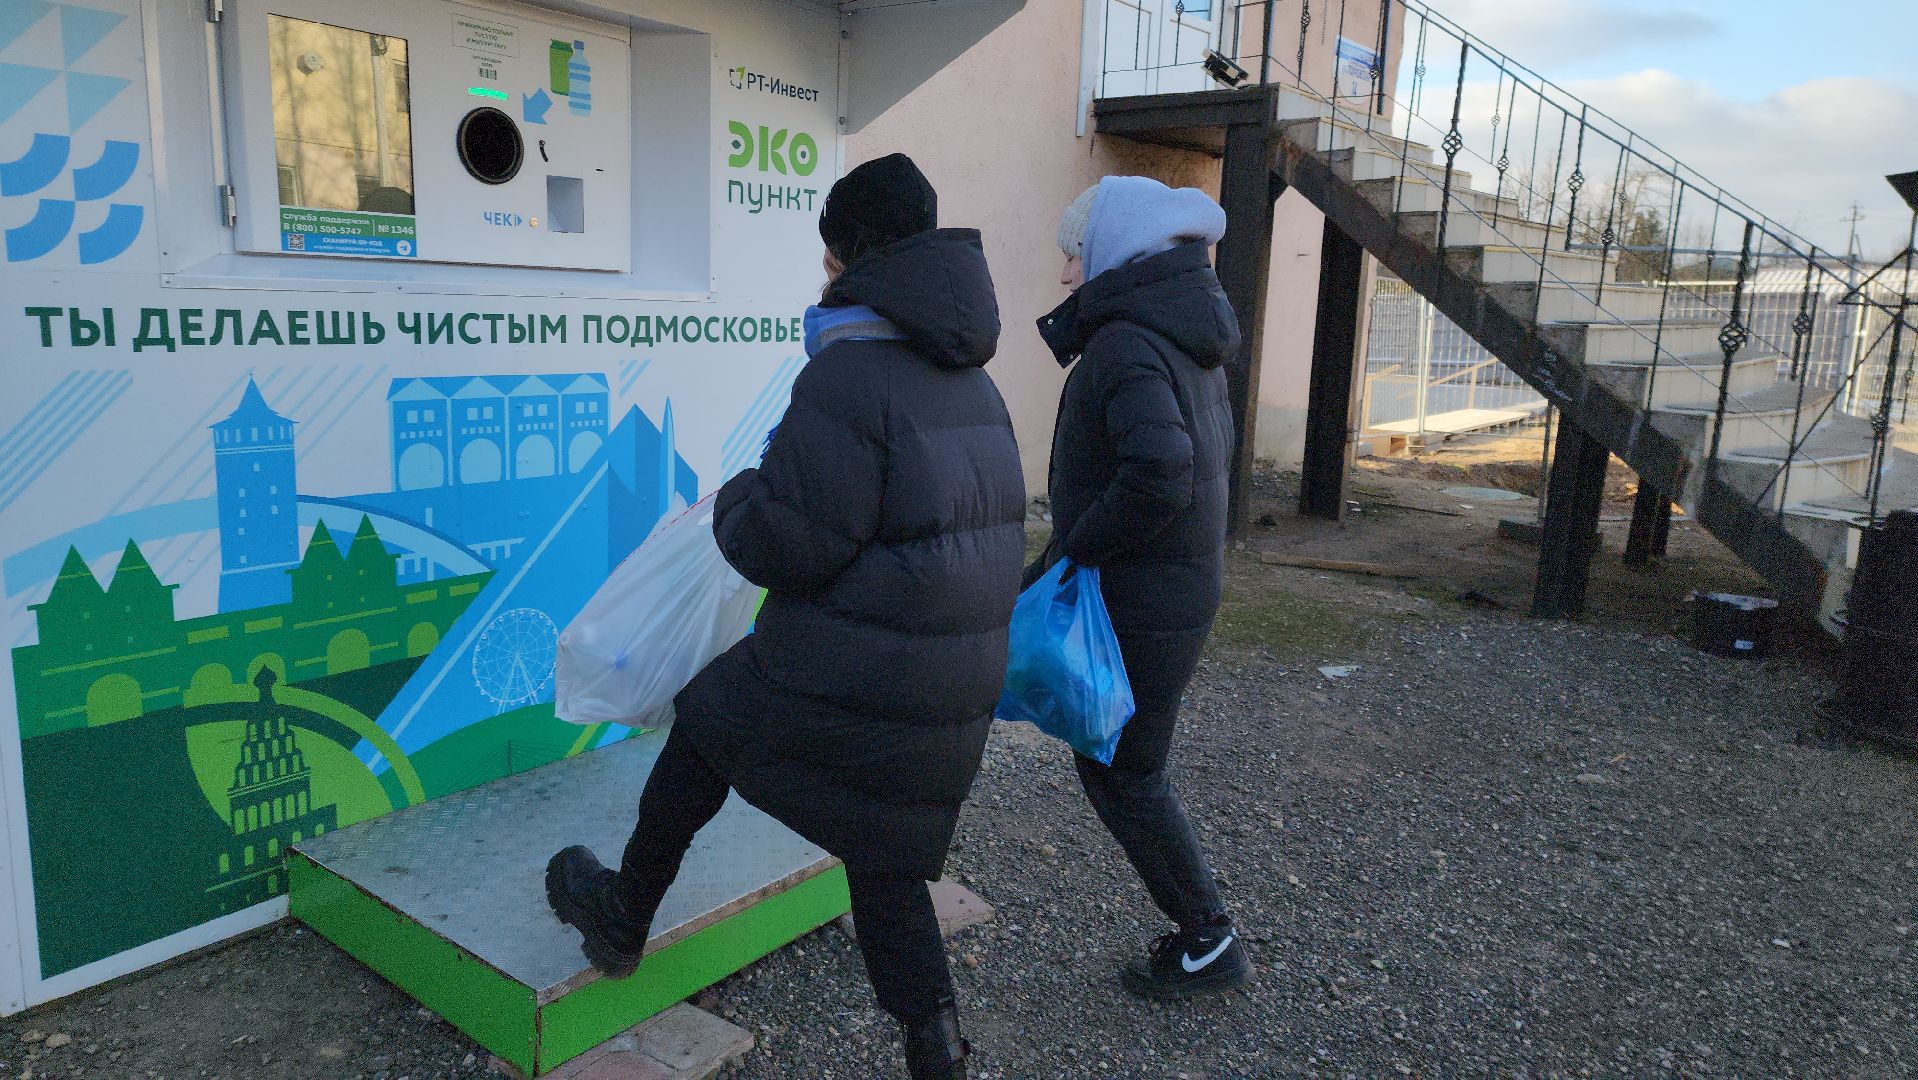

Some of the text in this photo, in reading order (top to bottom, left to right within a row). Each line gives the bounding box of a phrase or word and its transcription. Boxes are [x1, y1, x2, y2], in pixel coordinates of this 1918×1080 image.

[747, 72, 819, 102] РТ-Инвест
[728, 120, 818, 177] ЭКО
[293, 224, 318, 233] (800)
[483, 211, 512, 227] ЧЕК
[25, 306, 801, 352] ТЫ ДЕЛАЕШЬ ЧИСТЫМ ПОДМОСКОВЬЕ
